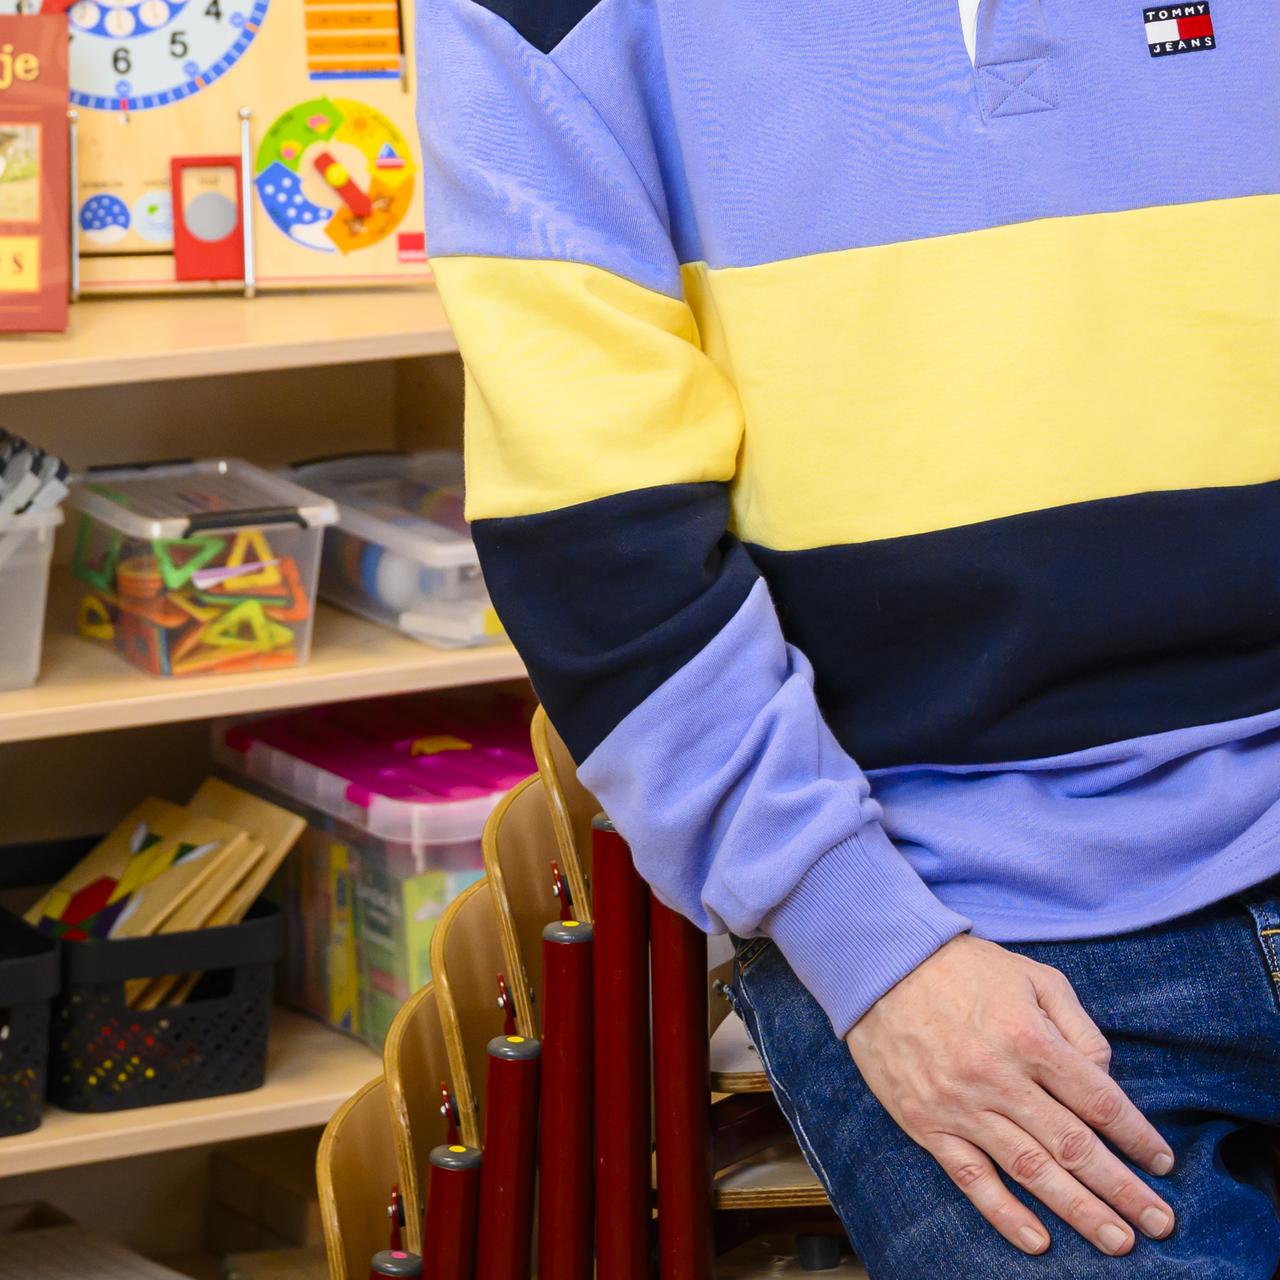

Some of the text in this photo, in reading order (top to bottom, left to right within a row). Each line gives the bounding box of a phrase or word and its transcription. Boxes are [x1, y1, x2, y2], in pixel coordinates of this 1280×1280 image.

[1146, 4, 1205, 20] TOMMY
[170, 31, 189, 58] 5
[1153, 36, 1212, 53] JEANS
[112, 47, 131, 74] 6
